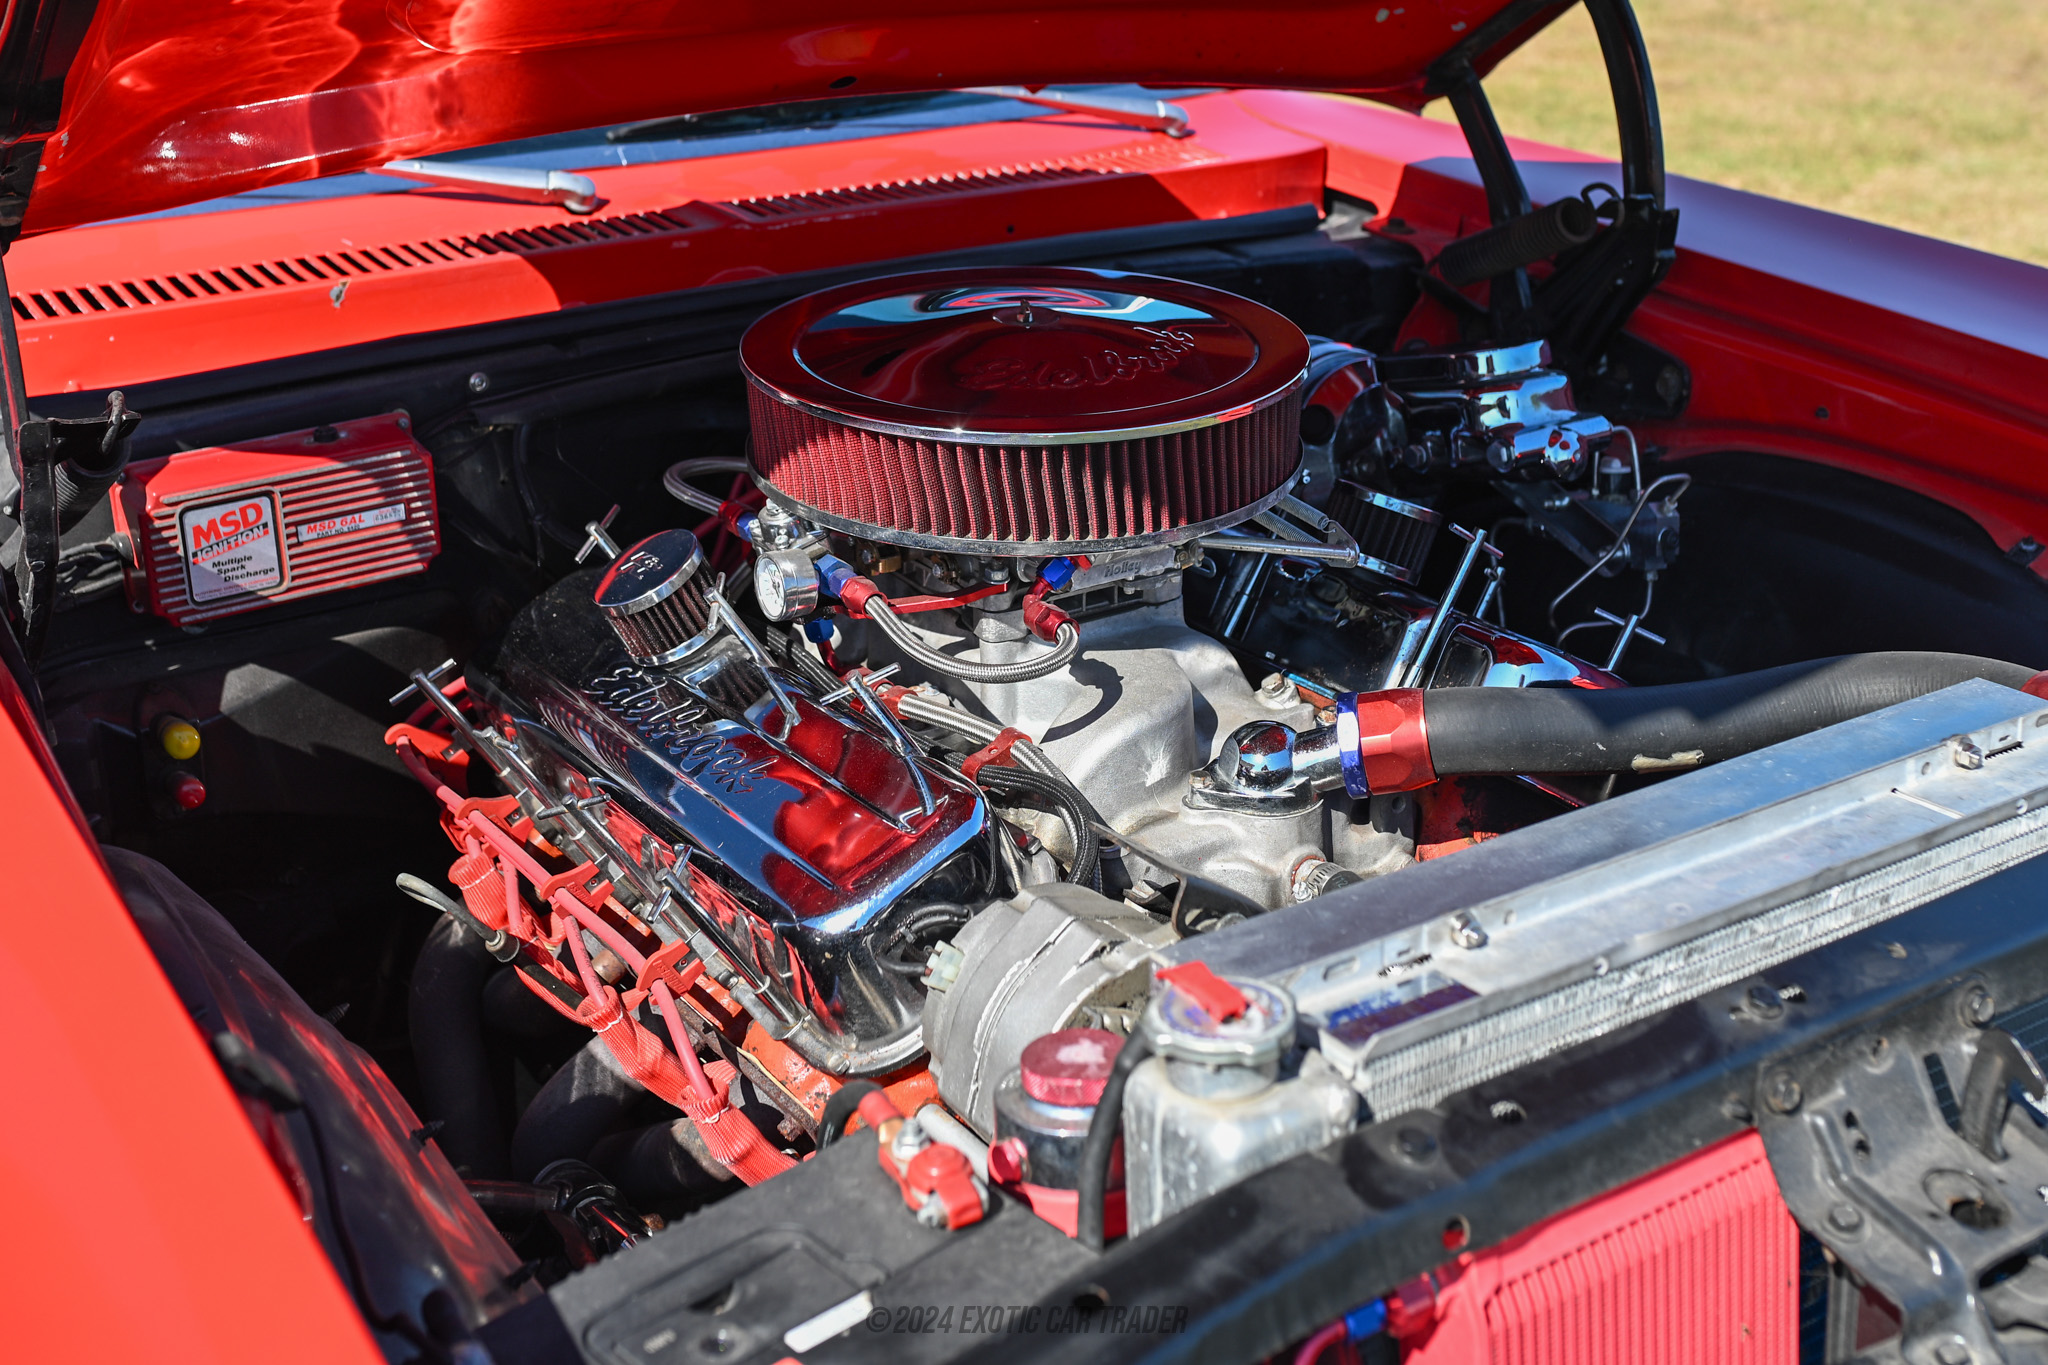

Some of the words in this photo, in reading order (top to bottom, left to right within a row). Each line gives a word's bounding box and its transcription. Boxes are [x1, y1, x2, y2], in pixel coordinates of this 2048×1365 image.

[192, 502, 264, 550] MSD
[306, 520, 336, 534] MSD
[340, 514, 366, 527] 6AL
[196, 523, 265, 562] IGNITION
[212, 555, 253, 569] Multiple
[216, 563, 247, 576] Spark
[1103, 560, 1141, 578] Holley
[224, 566, 275, 583] Discharge
